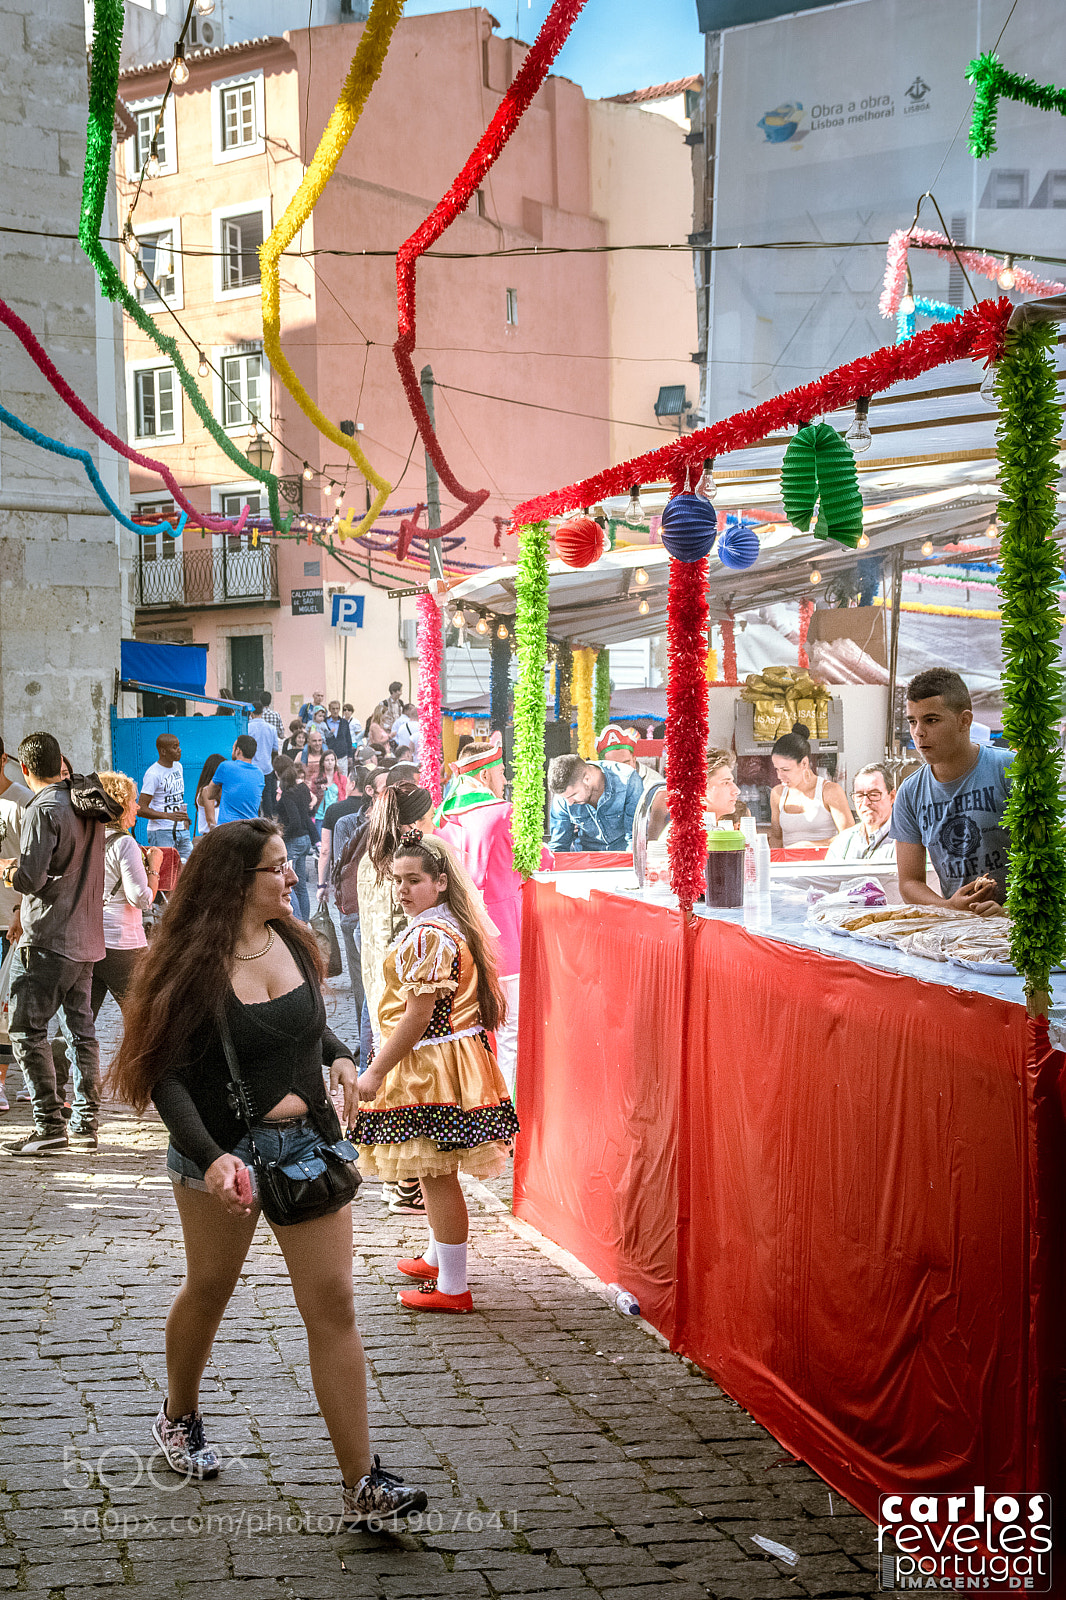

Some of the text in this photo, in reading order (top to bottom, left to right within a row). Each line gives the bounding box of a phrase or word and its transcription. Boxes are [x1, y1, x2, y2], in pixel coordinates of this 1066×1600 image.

[811, 103, 843, 119] Obra
[848, 102, 856, 113] a
[903, 103, 931, 114] LISBOA
[811, 106, 895, 131] Lisboa melhora!
[299, 605, 318, 613] MIGUEL
[339, 599, 357, 621] P
[607, 732, 621, 746] A
[922, 786, 997, 831] SOUTHERN
